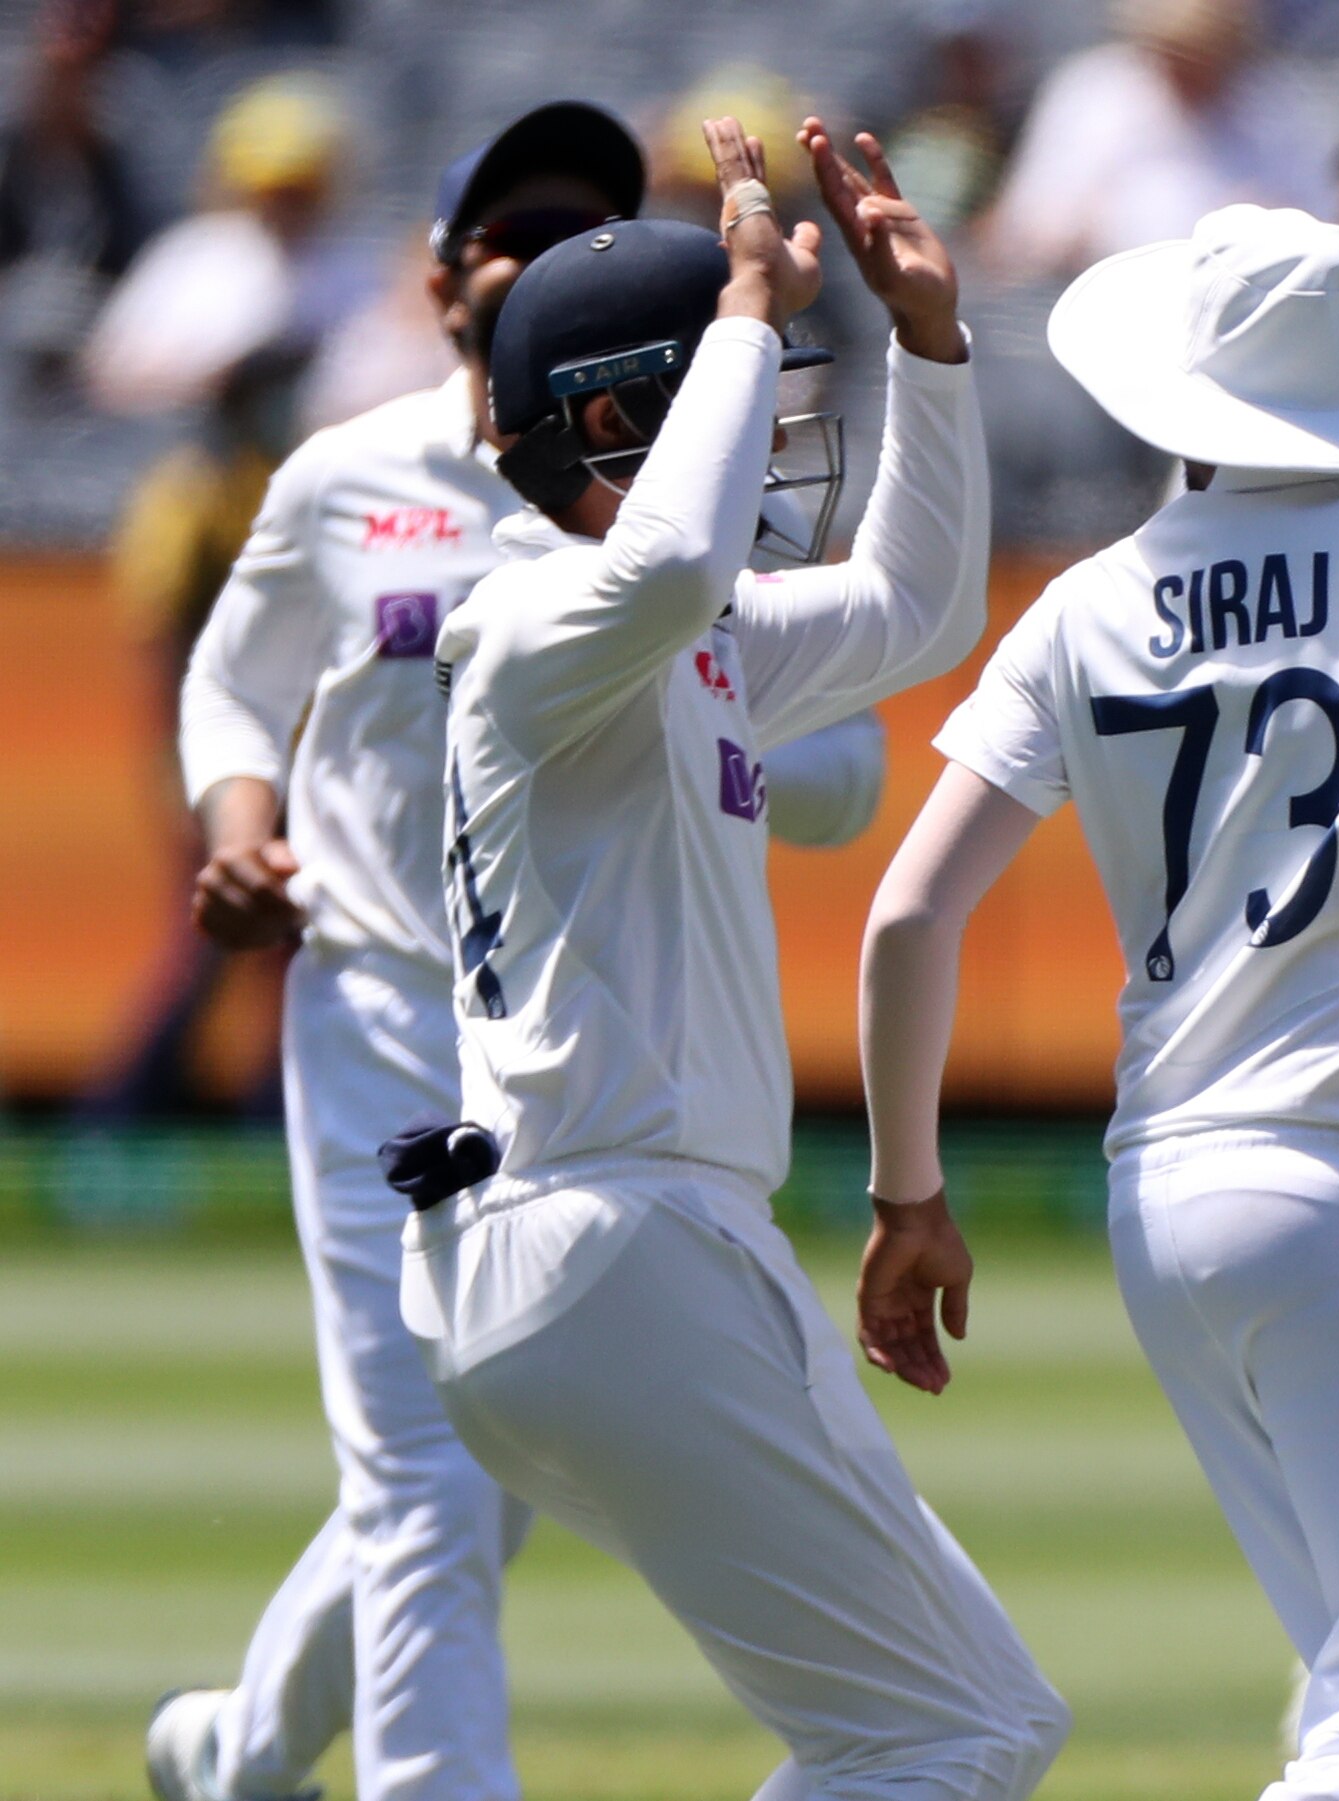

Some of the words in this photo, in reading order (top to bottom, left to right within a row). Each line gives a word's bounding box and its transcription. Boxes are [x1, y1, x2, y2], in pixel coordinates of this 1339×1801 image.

[595, 356, 641, 382] AIR
[363, 507, 463, 546] MPL
[1148, 552, 1329, 658] SIRAJ
